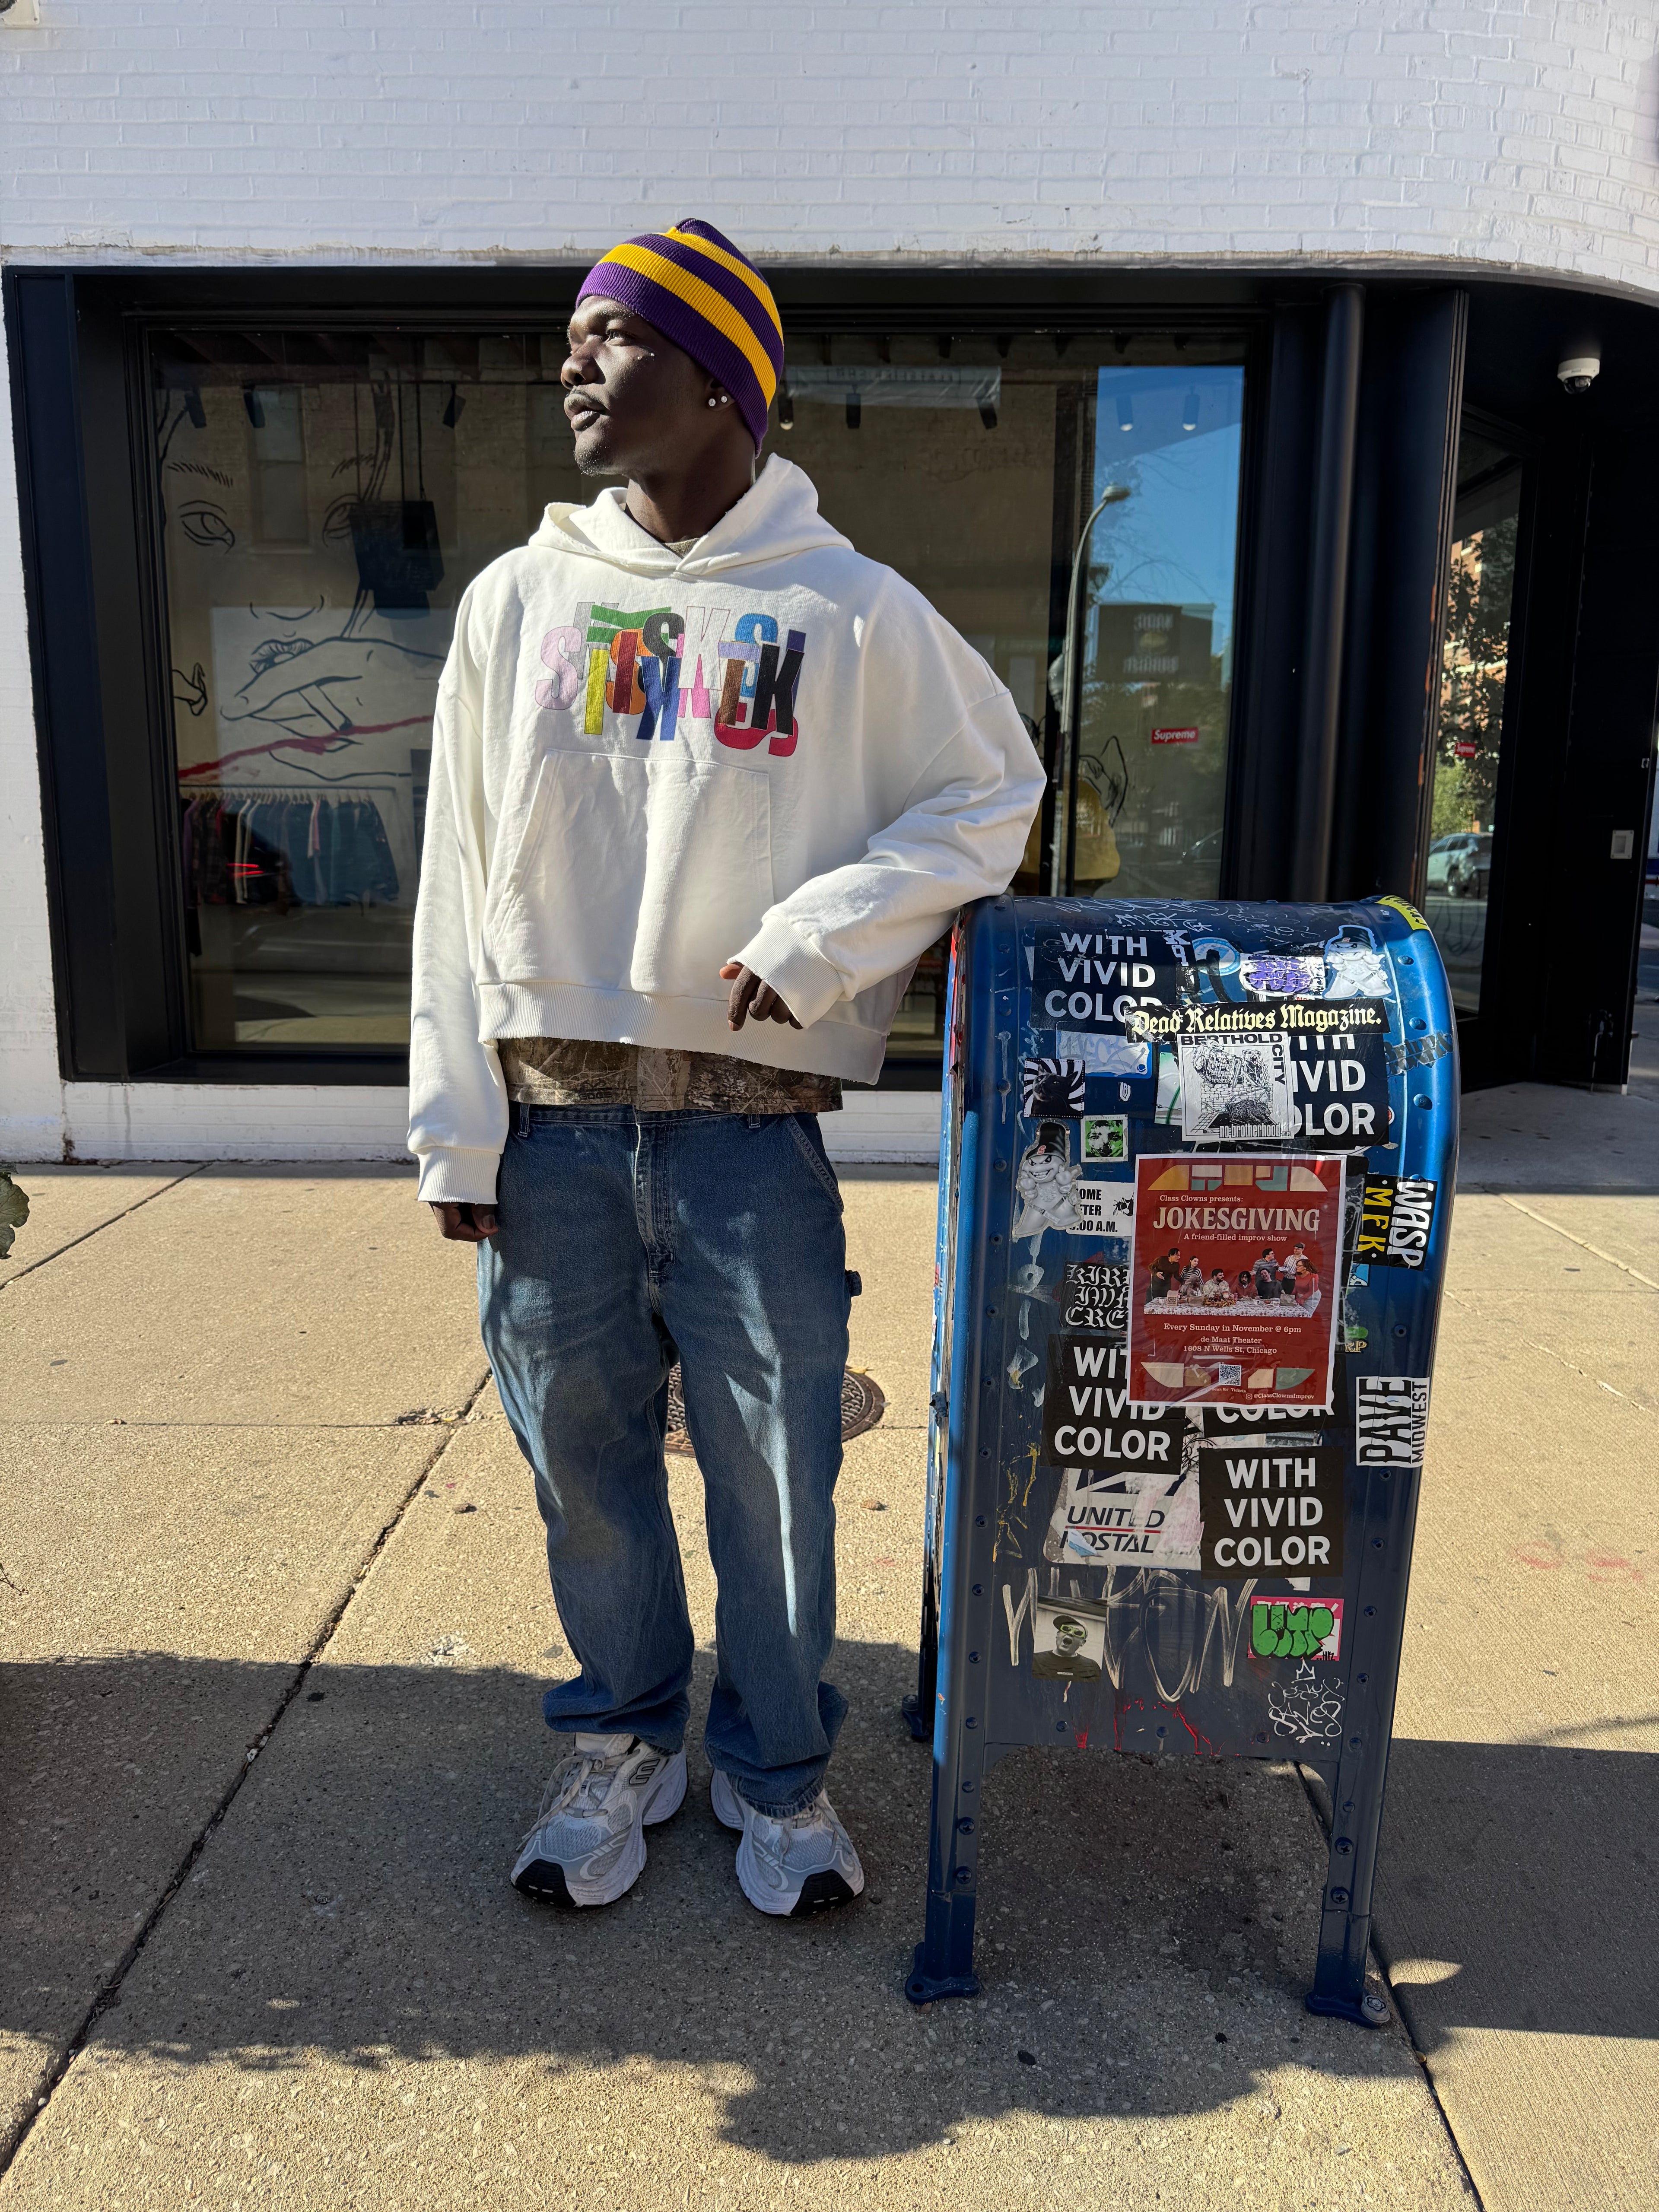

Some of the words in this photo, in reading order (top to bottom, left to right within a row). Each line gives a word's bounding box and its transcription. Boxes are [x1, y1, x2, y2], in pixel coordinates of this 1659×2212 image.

[1154, 729, 1195, 743] Supreme
[1060, 932, 1147, 957] WITH
[1058, 958, 1156, 988] VIVID
[1131, 1009, 1183, 1035] Dead
[1186, 1006, 1276, 1033] Relatives
[1280, 1003, 1382, 1032] Magazine.
[1180, 1033, 1283, 1045] BERTHOLD
[1272, 1044, 1286, 1085] CITY
[1290, 1060, 1366, 1092] IVID
[1294, 1103, 1375, 1136] LOR
[1076, 1189, 1102, 1200] OME
[1080, 1205, 1101, 1216] TER
[1096, 1220, 1118, 1232] A.M.
[1153, 1207, 1319, 1231] JOKESGIVING
[1387, 1181, 1434, 1269] WASP
[1238, 1234, 1265, 1242] improv
[1065, 1306, 1128, 1329] CRE
[1164, 1323, 1188, 1332] Every
[1189, 1324, 1219, 1332] Sunday
[1284, 1326, 1301, 1334] 6pm
[1073, 1346, 1127, 1379] WI
[1359, 1377, 1411, 1464] PAVE
[1412, 1381, 1427, 1464] MIDWEST
[1054, 1425, 1170, 1462] COLOR
[1225, 1457, 1316, 1489] WITH
[1224, 1497, 1323, 1528] VIVID
[1214, 1535, 1330, 1567] COLOR
